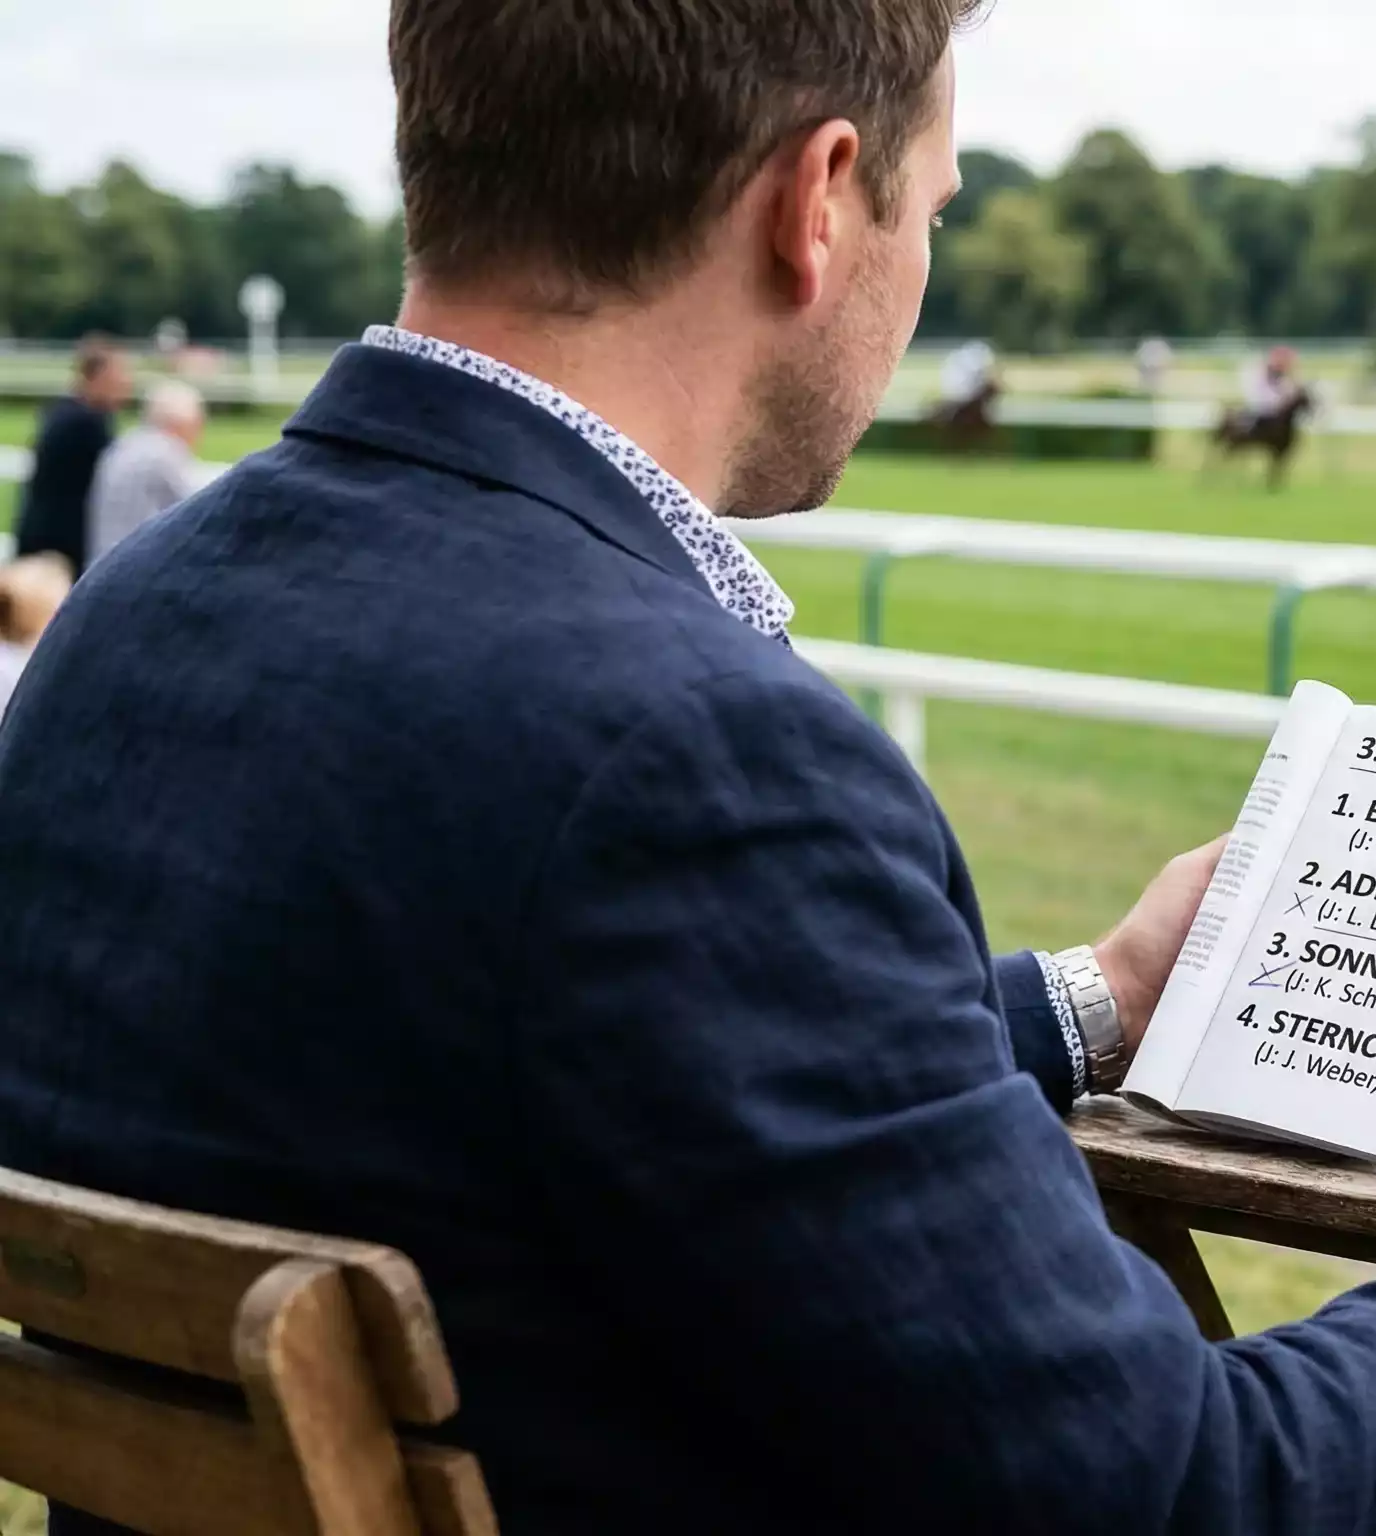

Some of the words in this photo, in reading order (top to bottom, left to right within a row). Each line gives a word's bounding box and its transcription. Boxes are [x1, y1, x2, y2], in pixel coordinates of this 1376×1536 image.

[1331, 793, 1355, 819] 1.
[1348, 828, 1373, 852] (J:
[1298, 861, 1323, 888] 2.
[1317, 898, 1343, 922] (J:
[1346, 906, 1362, 927] L.
[1265, 931, 1290, 958] 3.
[1284, 968, 1310, 993] (J:
[1313, 976, 1332, 999] K.
[1236, 1003, 1259, 1029] 4.
[1254, 1040, 1280, 1066] (J:
[1280, 1049, 1296, 1070] J.
